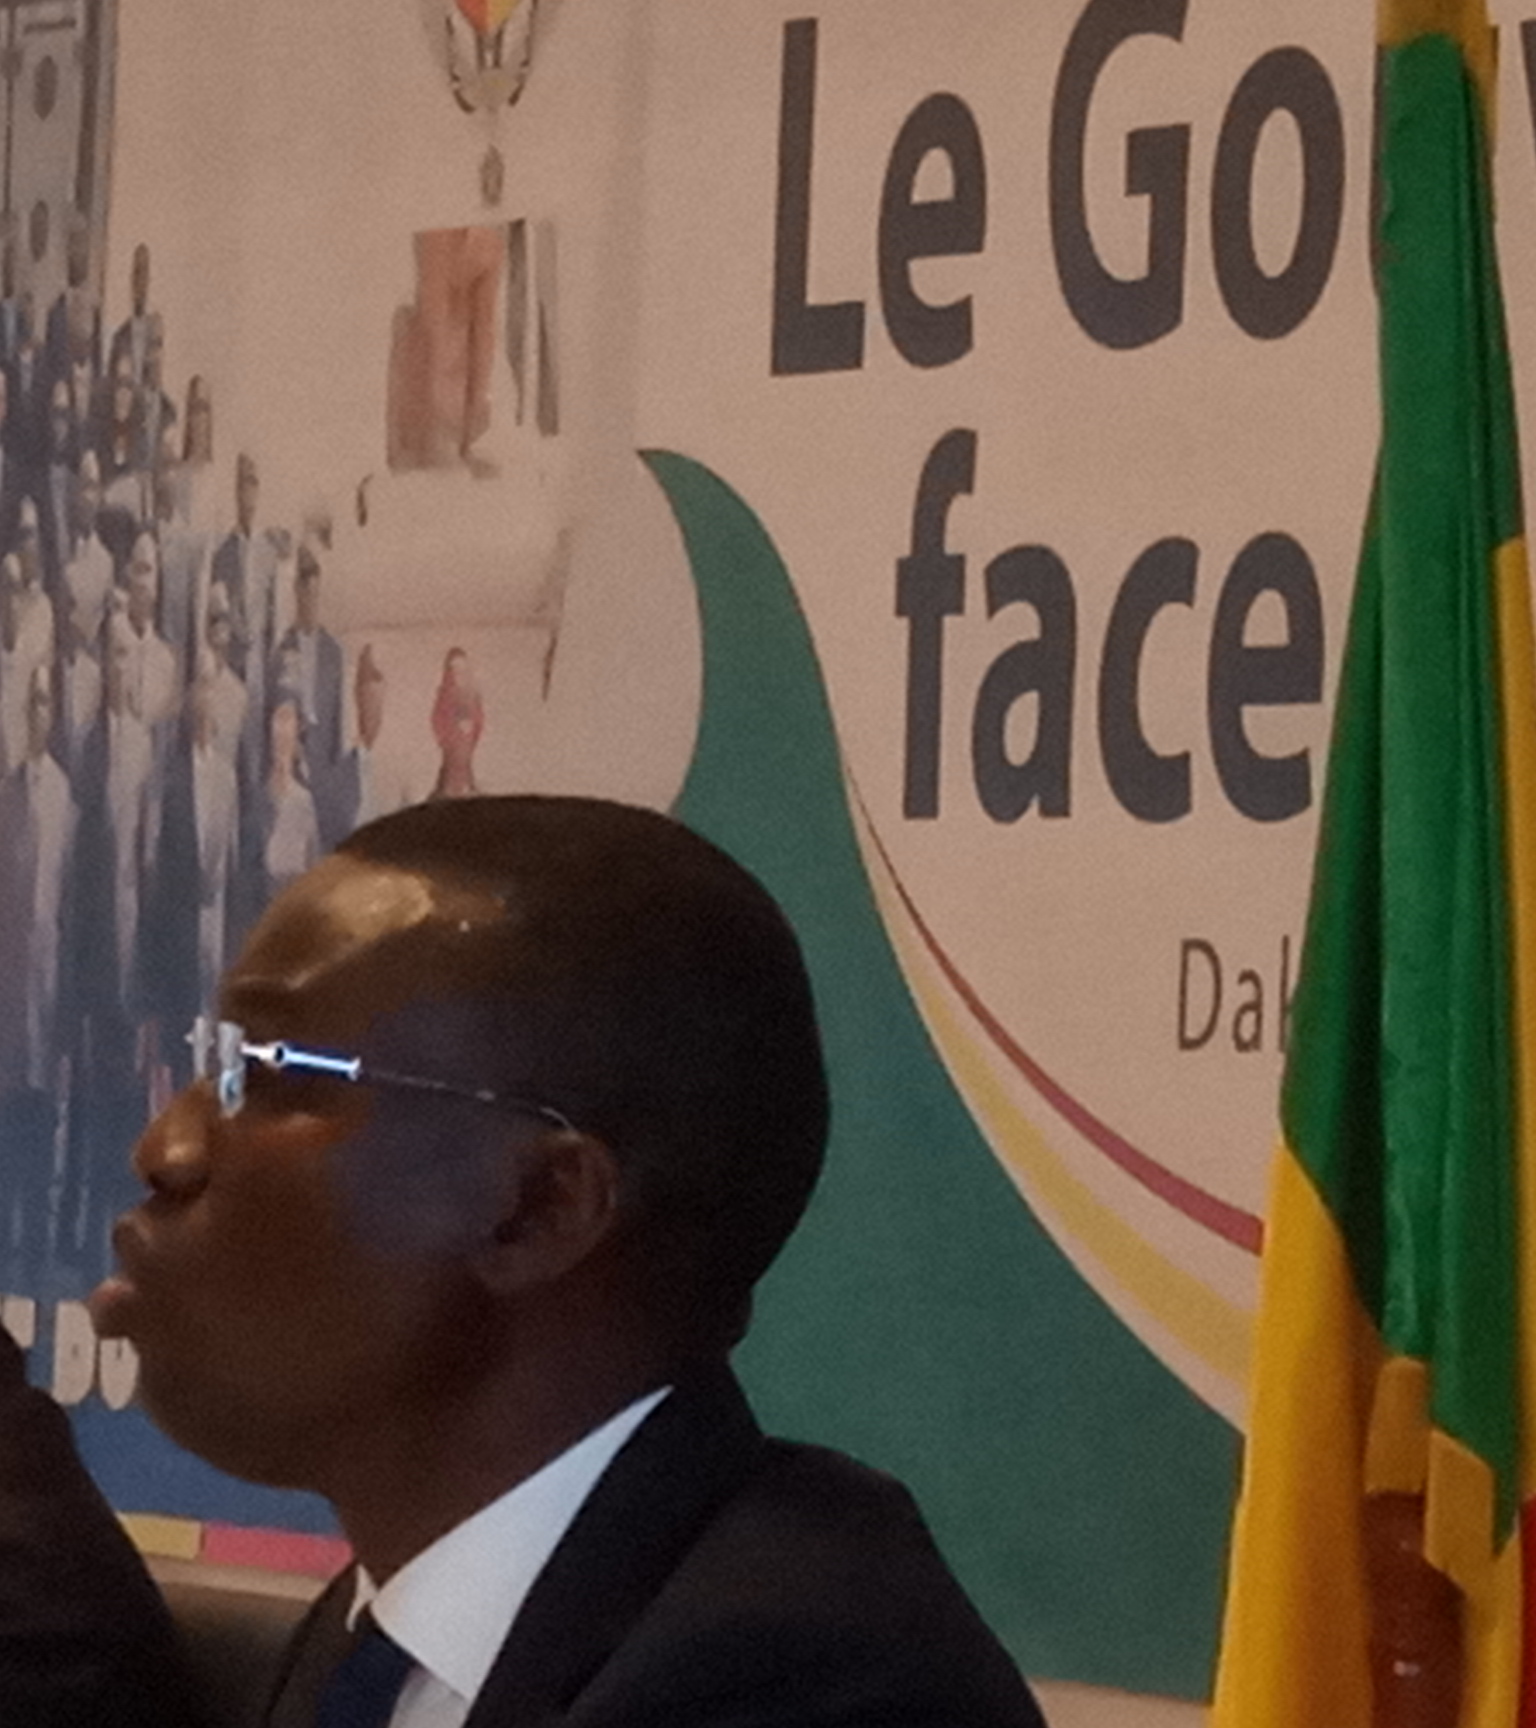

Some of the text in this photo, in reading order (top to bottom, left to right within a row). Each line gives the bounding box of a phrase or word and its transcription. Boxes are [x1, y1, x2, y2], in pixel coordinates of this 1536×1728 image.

[771, 0, 1536, 377] Le Go
[894, 427, 1325, 825] face
